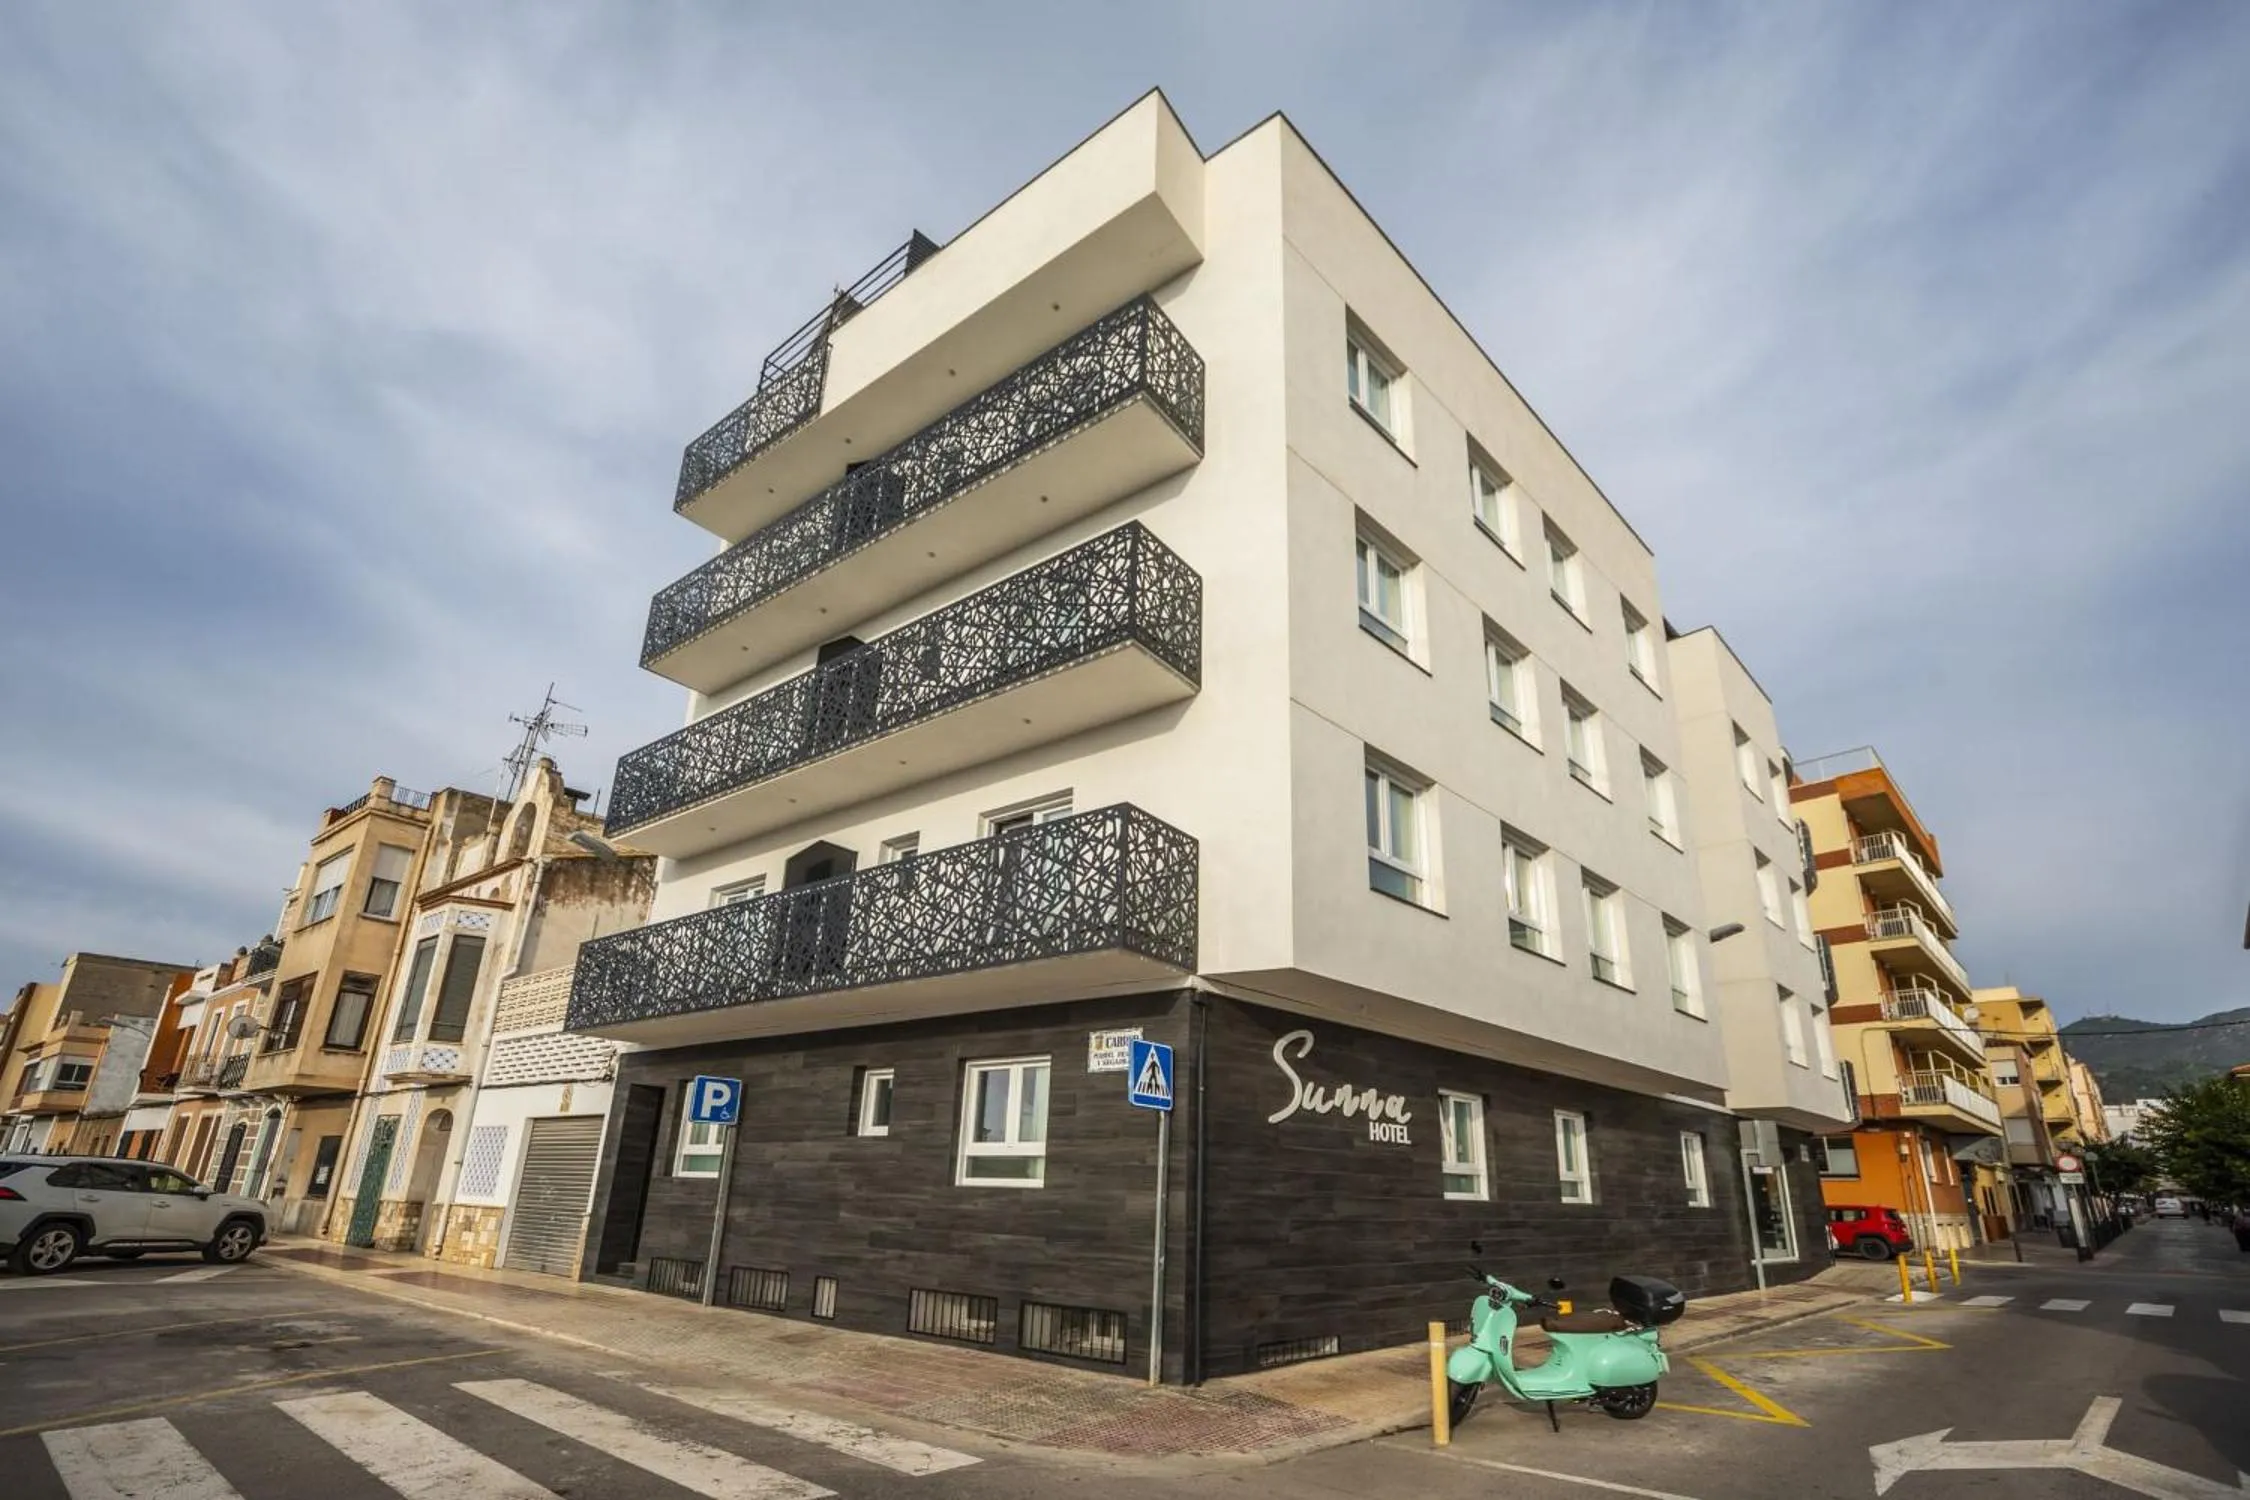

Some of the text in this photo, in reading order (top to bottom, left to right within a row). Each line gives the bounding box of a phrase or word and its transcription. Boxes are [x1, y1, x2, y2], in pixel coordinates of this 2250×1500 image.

[1268, 1029, 1412, 1124] Sunna
[700, 1081, 731, 1118] P
[1369, 1121, 1412, 1145] HOTEL
